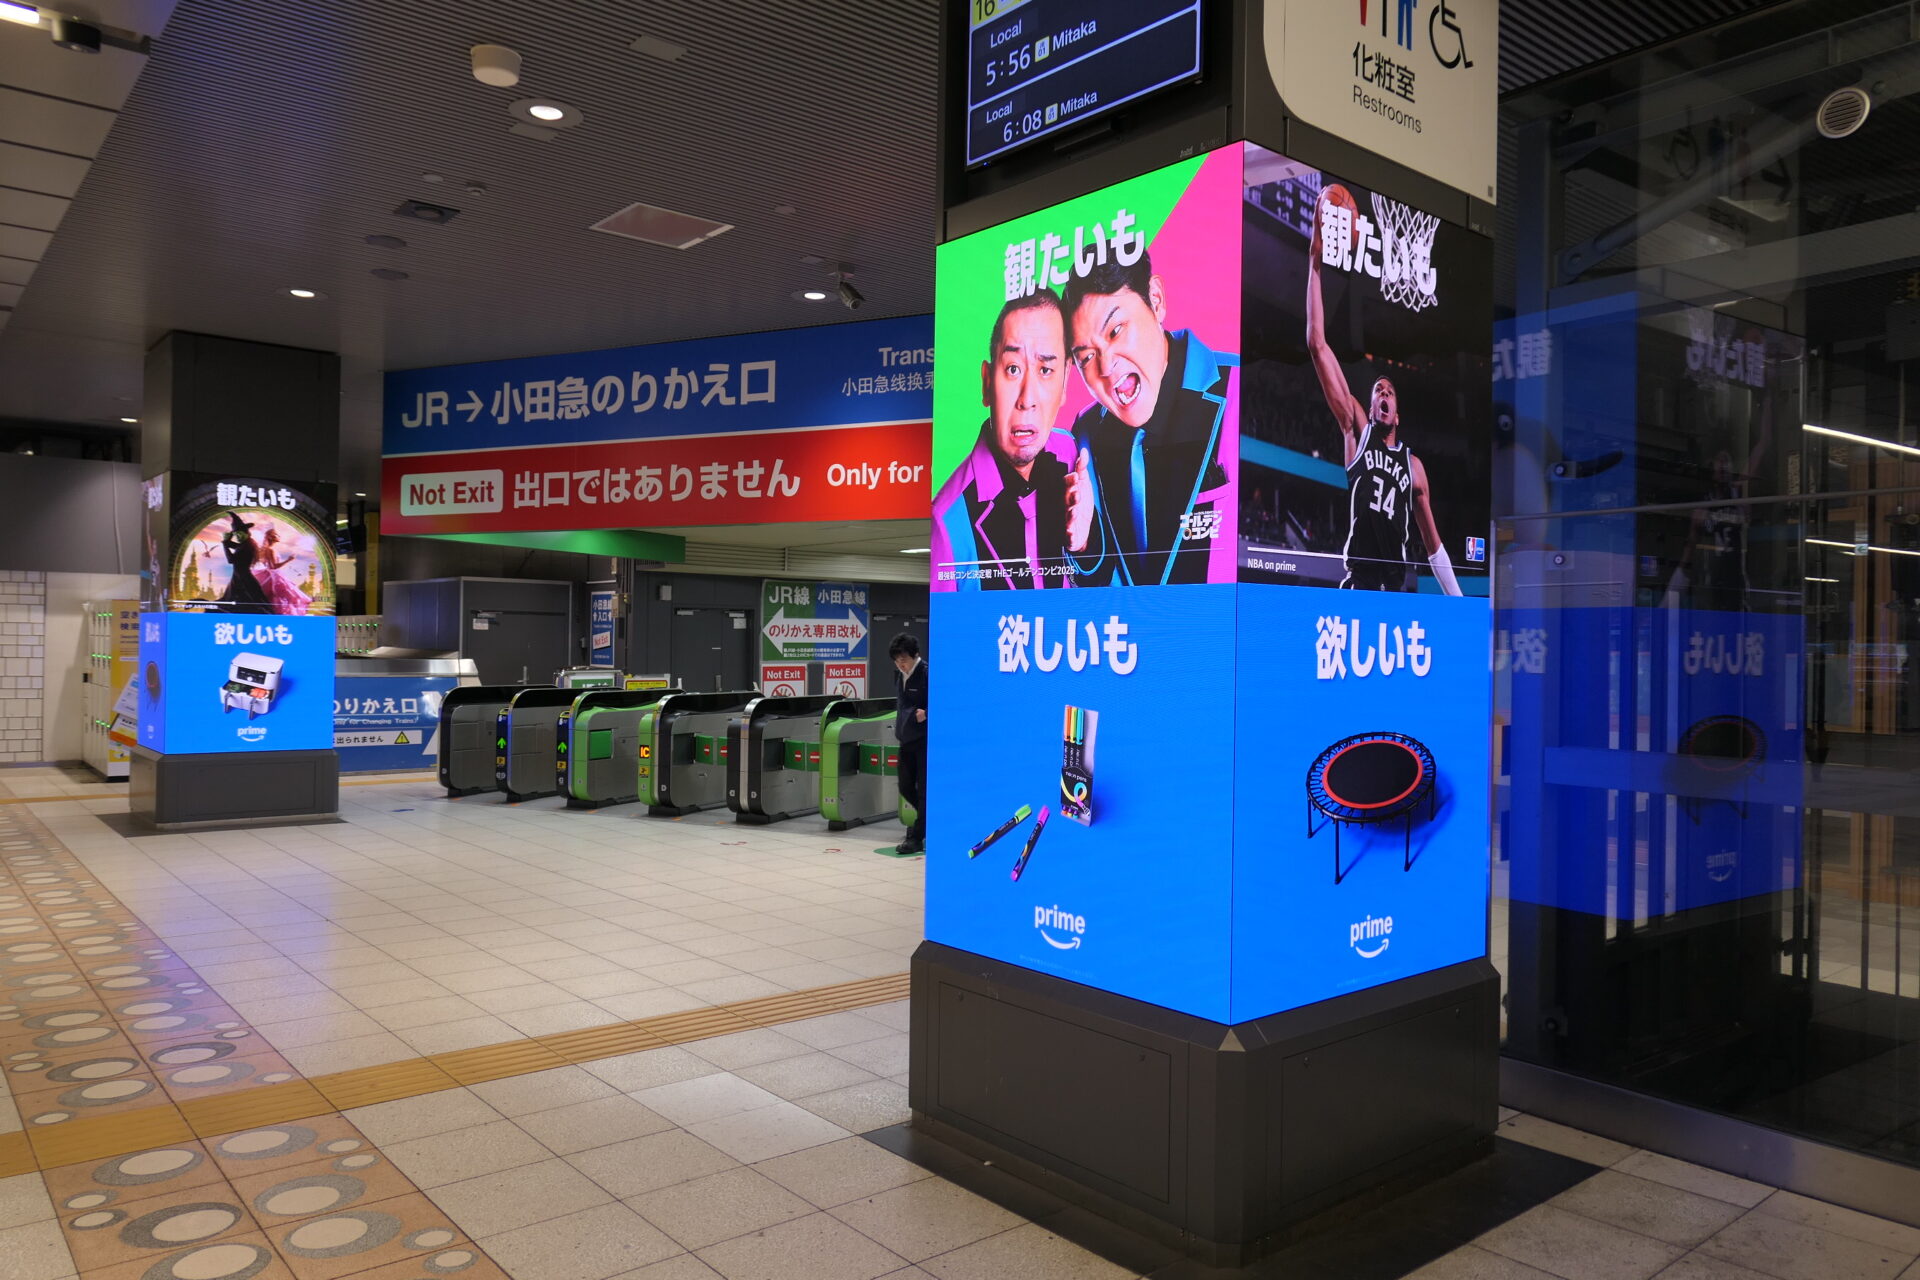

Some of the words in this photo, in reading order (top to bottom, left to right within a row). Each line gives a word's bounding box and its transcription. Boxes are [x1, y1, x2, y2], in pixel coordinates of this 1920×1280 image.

[976, 0, 996, 21] 16
[990, 19, 1022, 49] Local
[986, 44, 1031, 87] 5:56
[1052, 20, 1097, 51] Mitaka
[1353, 41, 1416, 104] 化粧室
[986, 101, 1013, 124] Local
[1003, 109, 1042, 142] 6:08
[1060, 91, 1098, 116] Mitaka
[1353, 85, 1422, 134] Restrooms
[1004, 208, 1145, 302] 観たいも
[1320, 199, 1437, 296] 観たいも
[490, 360, 777, 425] 小田急のりかえ口
[513, 459, 800, 509] 出口ではありません
[827, 462, 882, 490] Only
[888, 461, 924, 484] for
[1364, 449, 1410, 493] BUCKS
[217, 483, 296, 510] 観たいも
[409, 483, 446, 506] Not
[453, 480, 495, 504] Exit
[1369, 475, 1397, 520] 34
[938, 568, 993, 581] 最強新コンビ決定戦
[993, 565, 1075, 578] THEゴールデンコンビ2025
[1247, 557, 1264, 569] NBA
[1264, 561, 1274, 570] on
[1275, 560, 1296, 573] prime
[769, 586, 810, 605] JR線
[818, 589, 866, 605] 小田急線
[214, 623, 293, 646] 欲しいも
[769, 624, 862, 638] のりかえ専用改札
[998, 614, 1138, 675] 欲しいも
[1316, 616, 1433, 680] 欲しいも
[766, 670, 782, 679] Not
[783, 670, 801, 679] Exit
[829, 668, 844, 677] Not
[845, 668, 861, 676] Exit
[237, 726, 267, 738] prime
[362, 716, 392, 725] Changing
[333, 735, 384, 745] 出られません
[640, 747, 650, 758] IC
[1034, 904, 1086, 936] prime
[1350, 915, 1393, 948] prime
